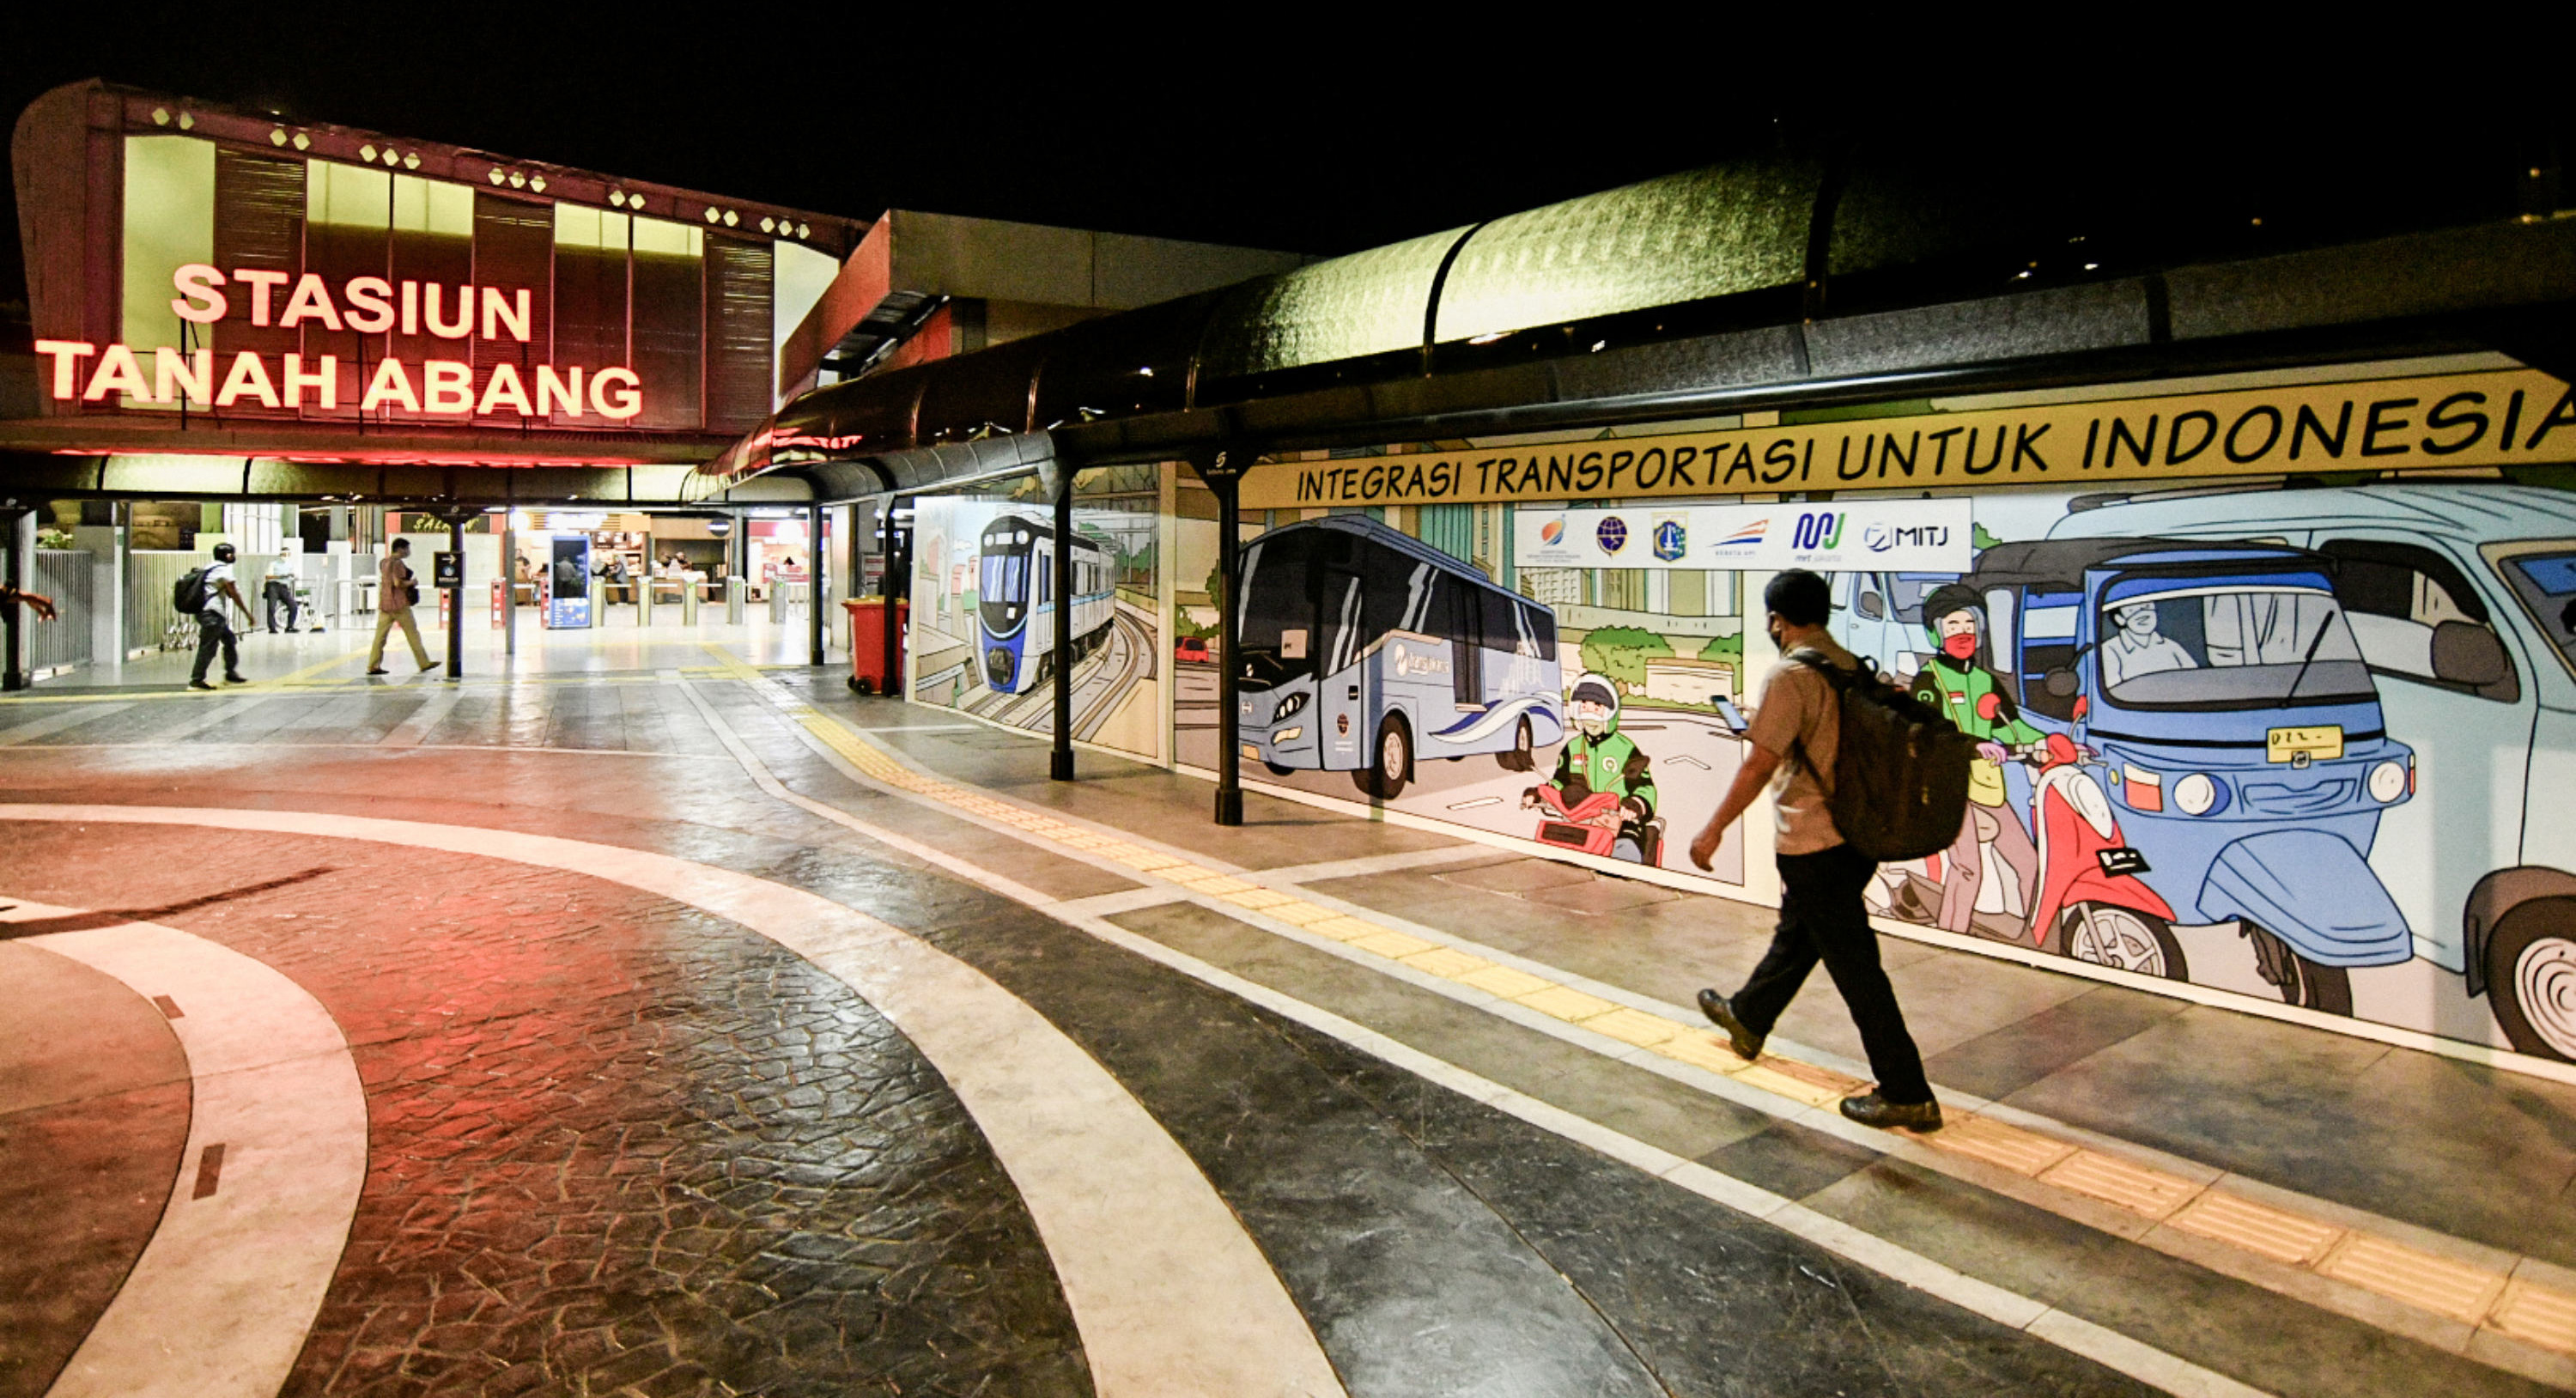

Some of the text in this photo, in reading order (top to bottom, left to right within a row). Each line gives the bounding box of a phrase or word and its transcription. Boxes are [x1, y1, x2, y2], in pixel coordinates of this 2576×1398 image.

[171, 263, 531, 342] STASIUN
[34, 340, 642, 419] TANAH ABANG
[1296, 383, 2576, 501] INTEGRASI TRANSPORTASI UNTUK INDONESIA
[1896, 526, 1948, 546] MITJ
